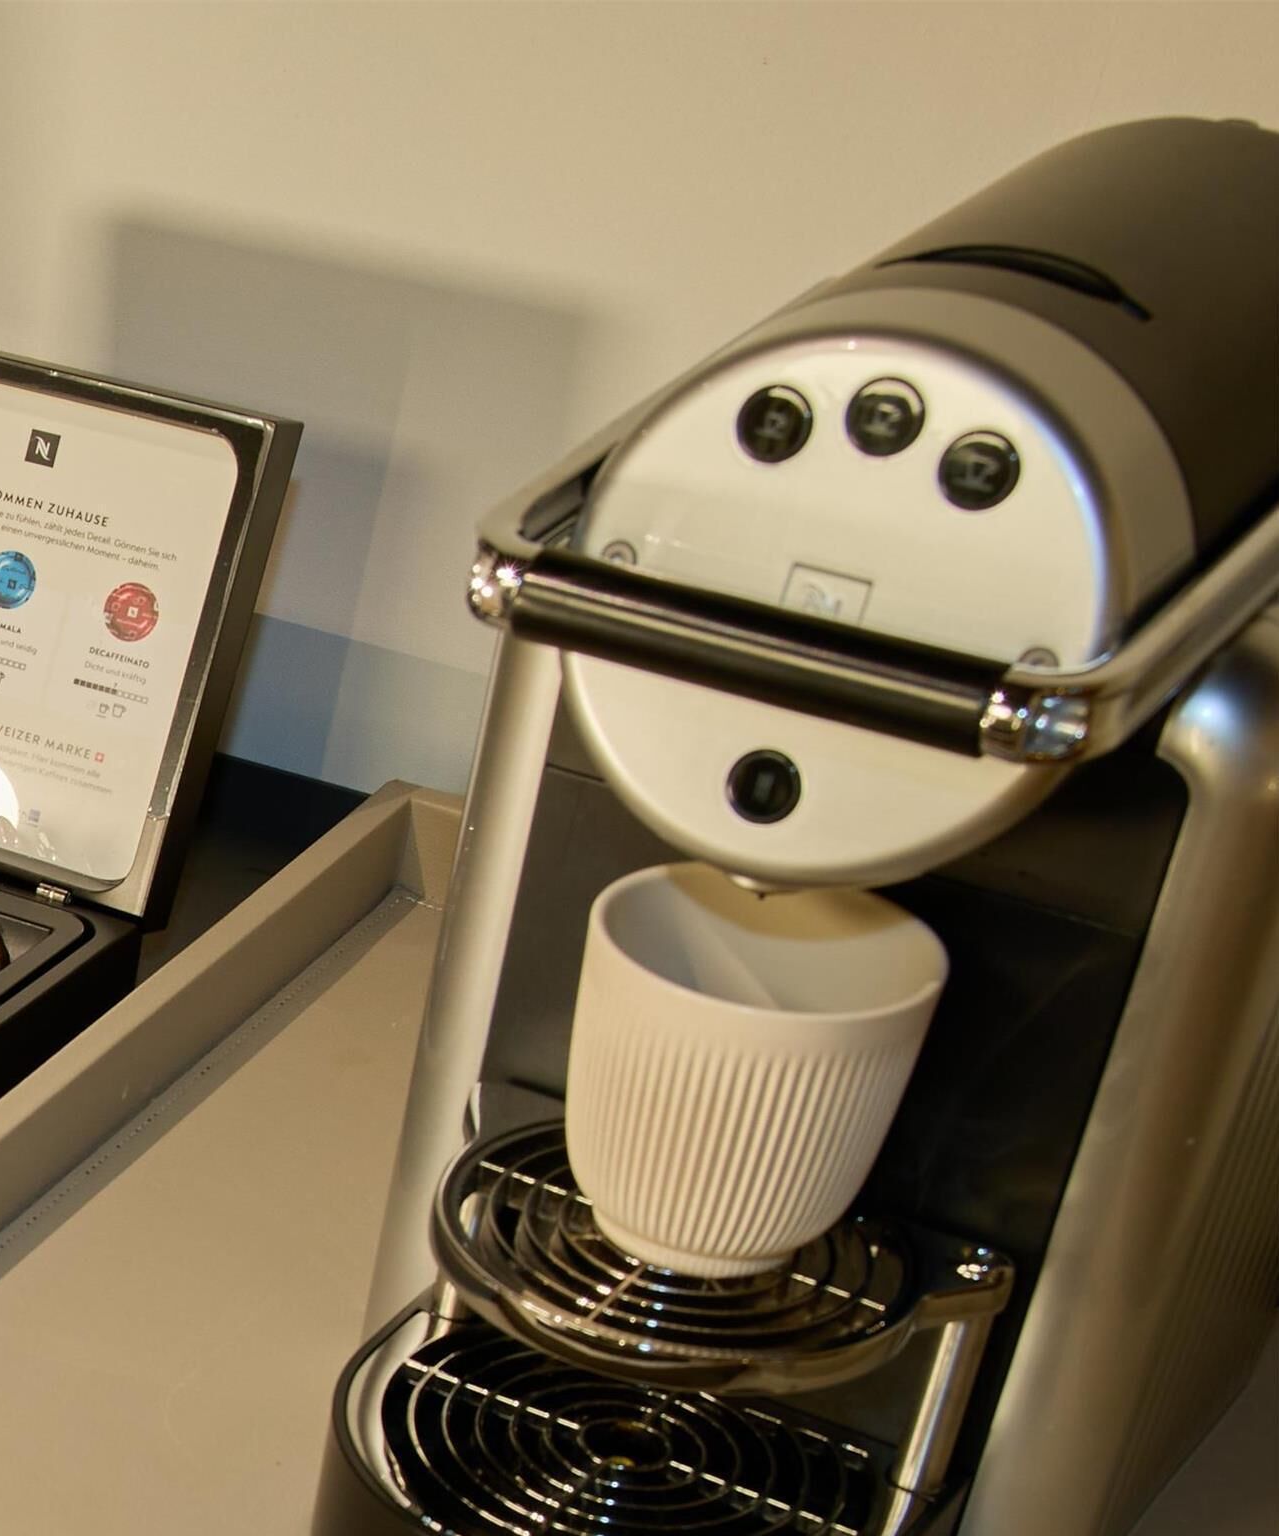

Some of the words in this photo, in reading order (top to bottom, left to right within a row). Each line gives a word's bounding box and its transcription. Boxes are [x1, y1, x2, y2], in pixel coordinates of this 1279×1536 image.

[48, 502, 109, 528] ZUHAUSE
[1, 524, 24, 535] einen
[24, 530, 86, 552] unvergesslichen
[87, 546, 120, 560] Moment
[90, 646, 150, 670] DECAFFEINATO
[44, 739, 92, 760] MARKE
